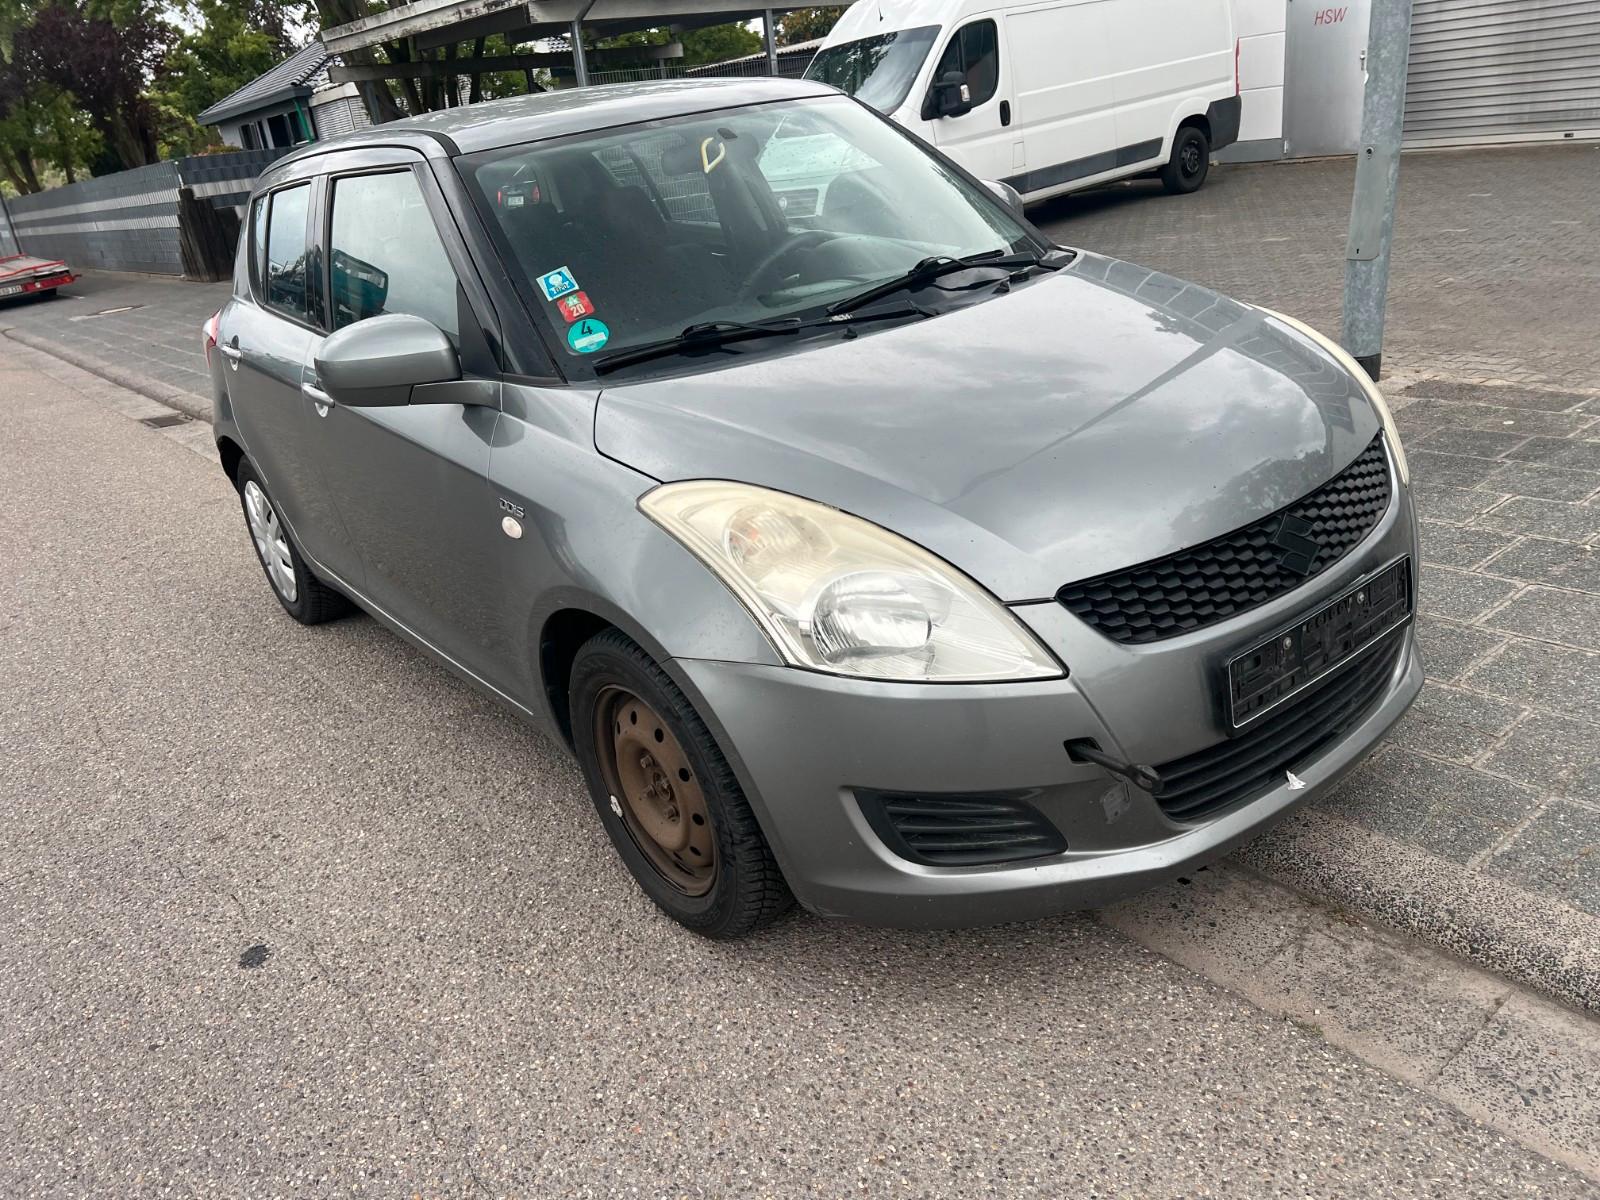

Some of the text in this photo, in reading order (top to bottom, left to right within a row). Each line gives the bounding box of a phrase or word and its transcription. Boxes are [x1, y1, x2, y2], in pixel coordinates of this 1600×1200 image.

[1314, 6, 1348, 25] HSW
[570, 304, 586, 317] 20
[581, 320, 593, 335] 4
